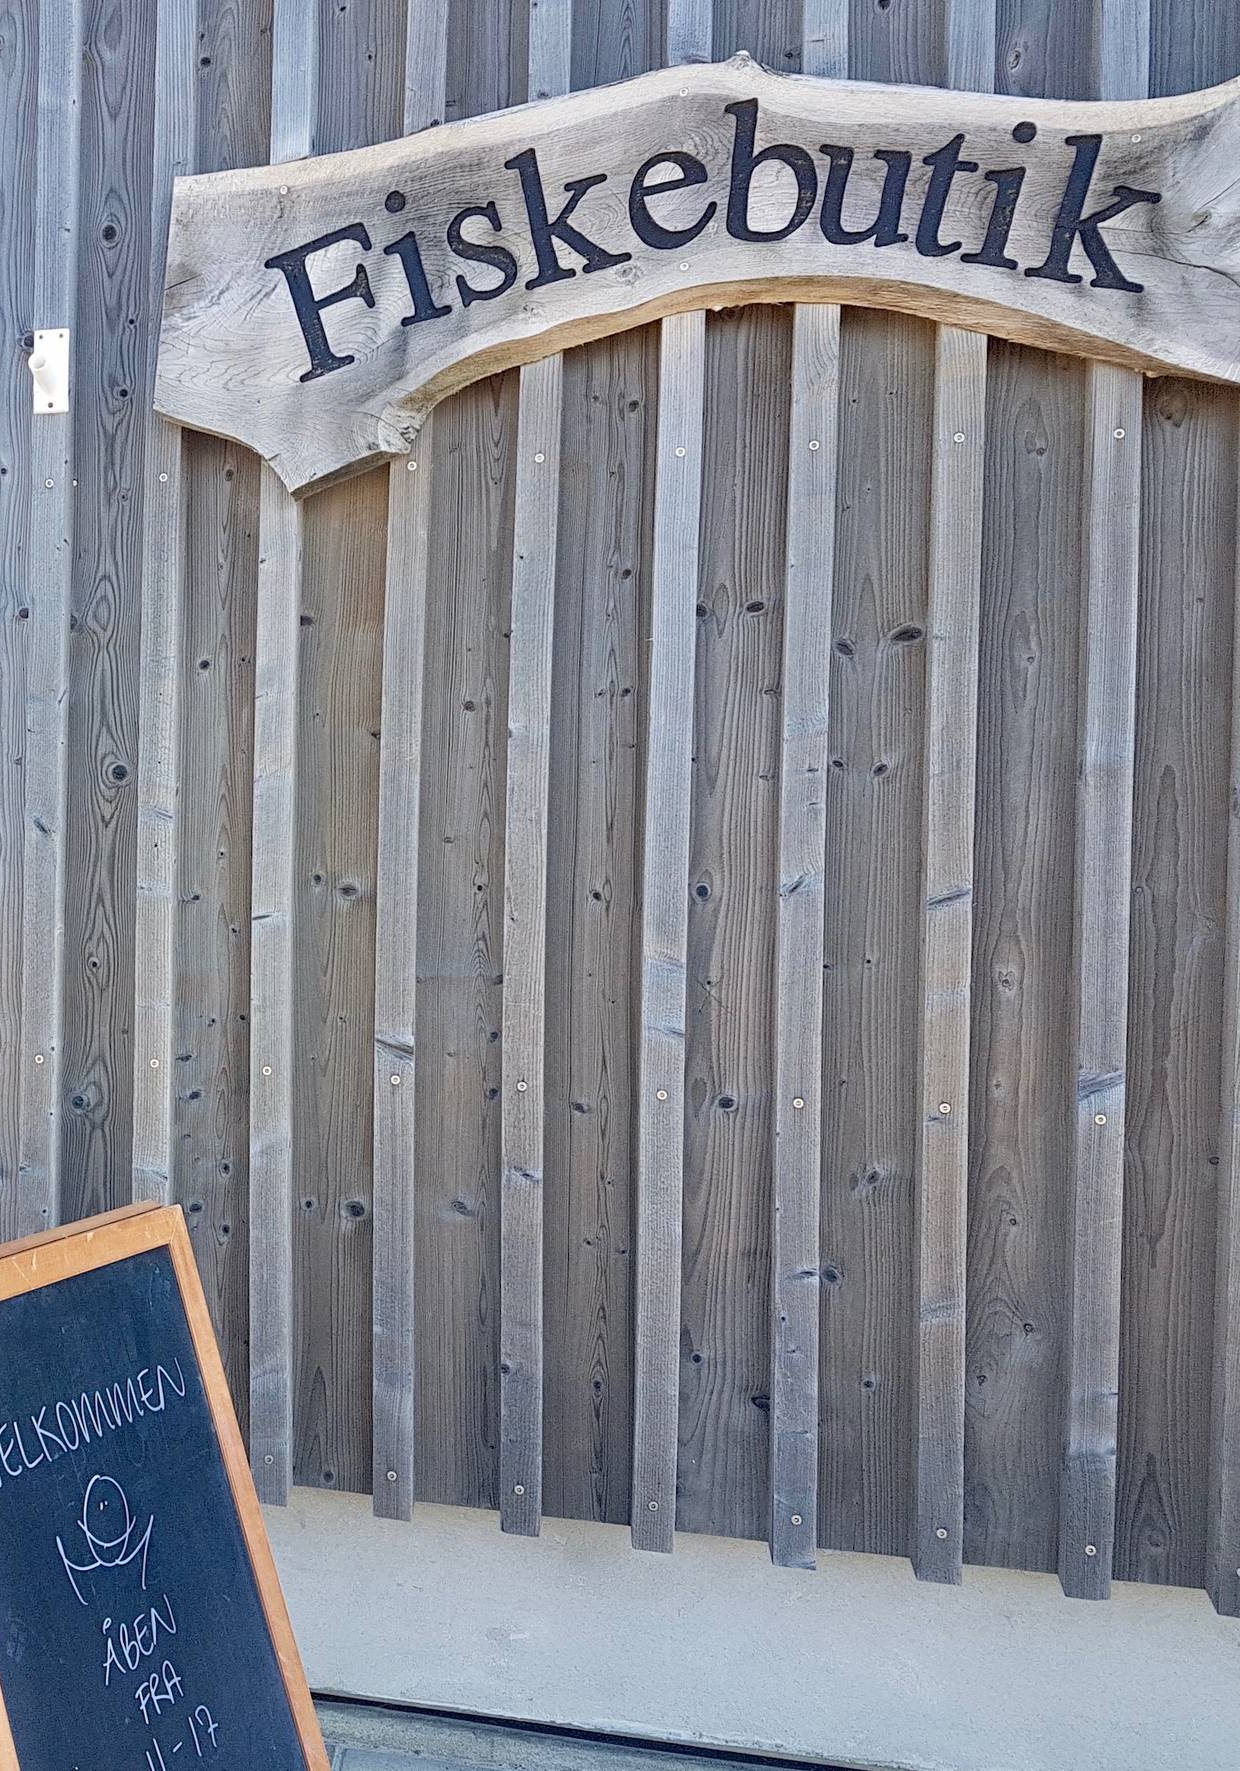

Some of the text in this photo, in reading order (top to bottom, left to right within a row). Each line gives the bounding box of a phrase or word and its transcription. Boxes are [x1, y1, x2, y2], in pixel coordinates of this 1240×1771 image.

[264, 98, 1161, 383] Fiskebutik
[102, 1594, 176, 1686] ÅBEN
[135, 1660, 184, 1724] FRA
